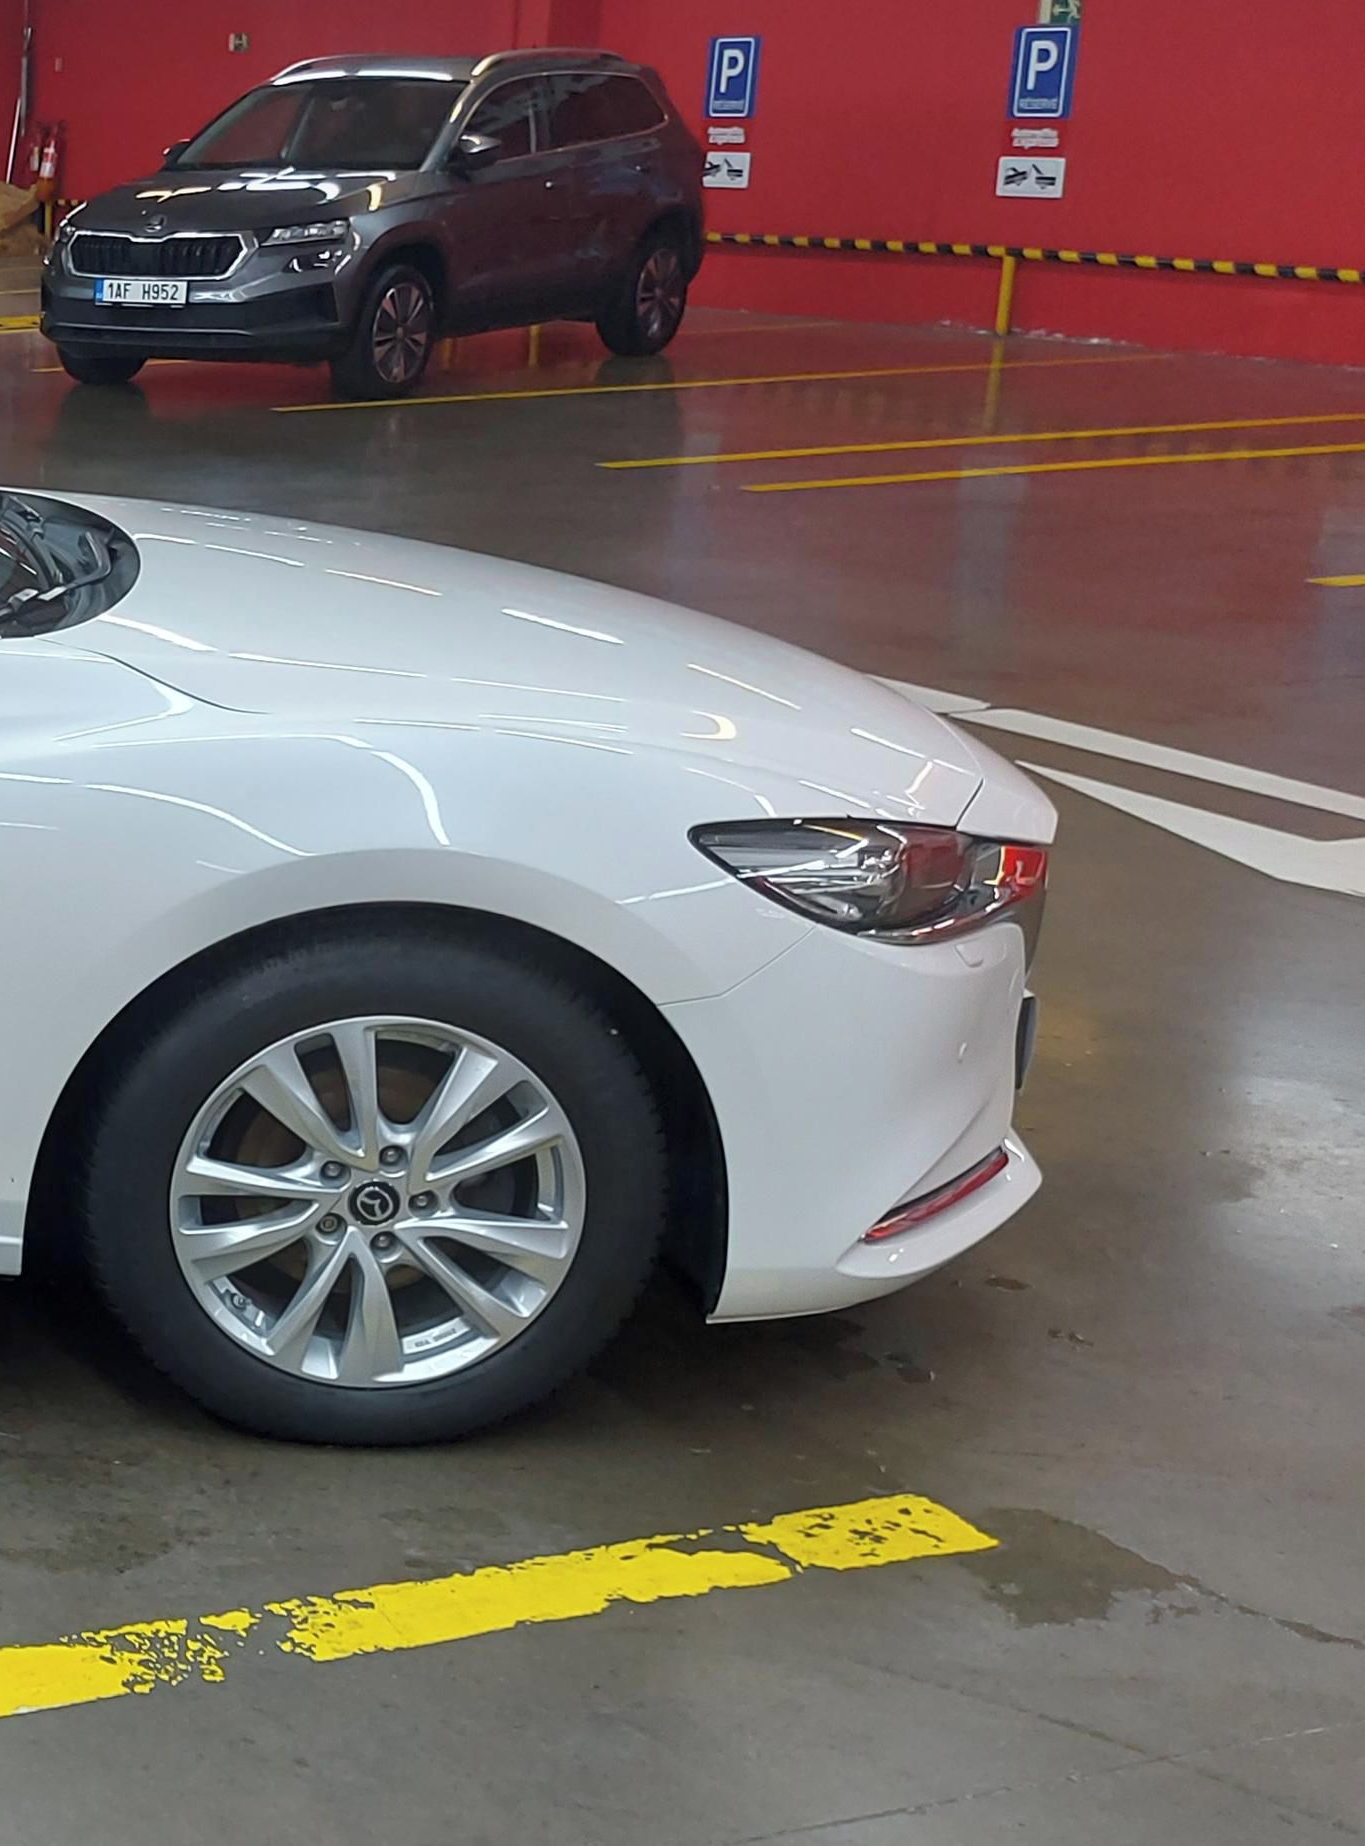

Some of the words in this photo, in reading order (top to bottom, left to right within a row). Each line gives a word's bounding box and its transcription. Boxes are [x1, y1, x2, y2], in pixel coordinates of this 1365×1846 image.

[719, 48, 745, 93] P
[1026, 40, 1059, 91] P
[109, 282, 131, 299] 1AF
[142, 283, 179, 301] H952
